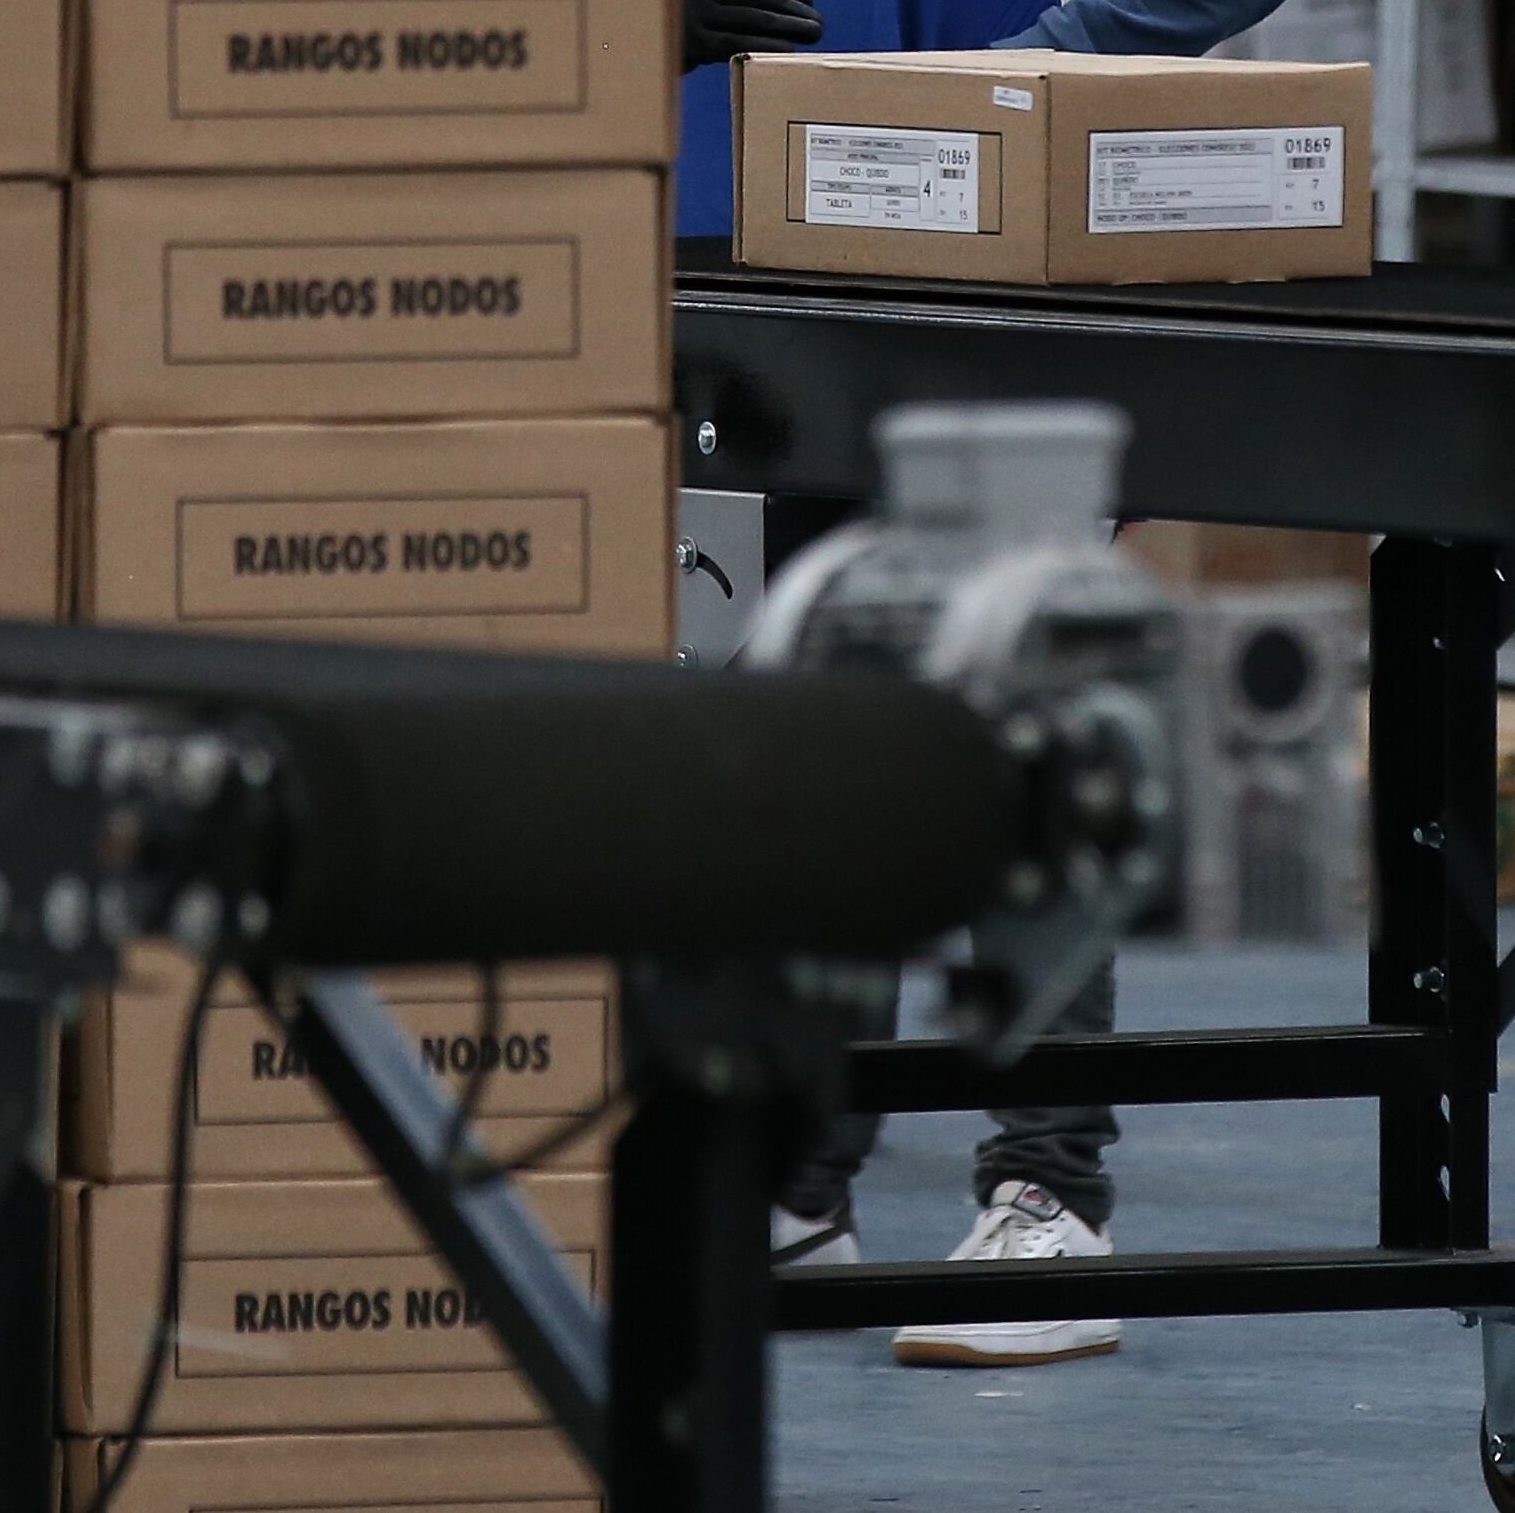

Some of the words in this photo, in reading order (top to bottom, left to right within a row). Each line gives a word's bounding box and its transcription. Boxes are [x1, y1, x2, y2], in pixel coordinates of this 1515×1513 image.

[227, 31, 384, 74] RANGOS
[396, 29, 528, 71] NODOS
[1284, 137, 1332, 154] 01869
[938, 148, 971, 166] 01869
[923, 180, 932, 198] 4
[1312, 179, 1320, 190] 7
[959, 192, 964, 203] 7
[1312, 200, 1326, 212] 15
[221, 277, 377, 320] RANGOS
[390, 276, 521, 317] NODOS
[234, 534, 388, 575] RANGOS
[402, 530, 531, 572] NODOS
[234, 1291, 393, 1334] RANGOS
